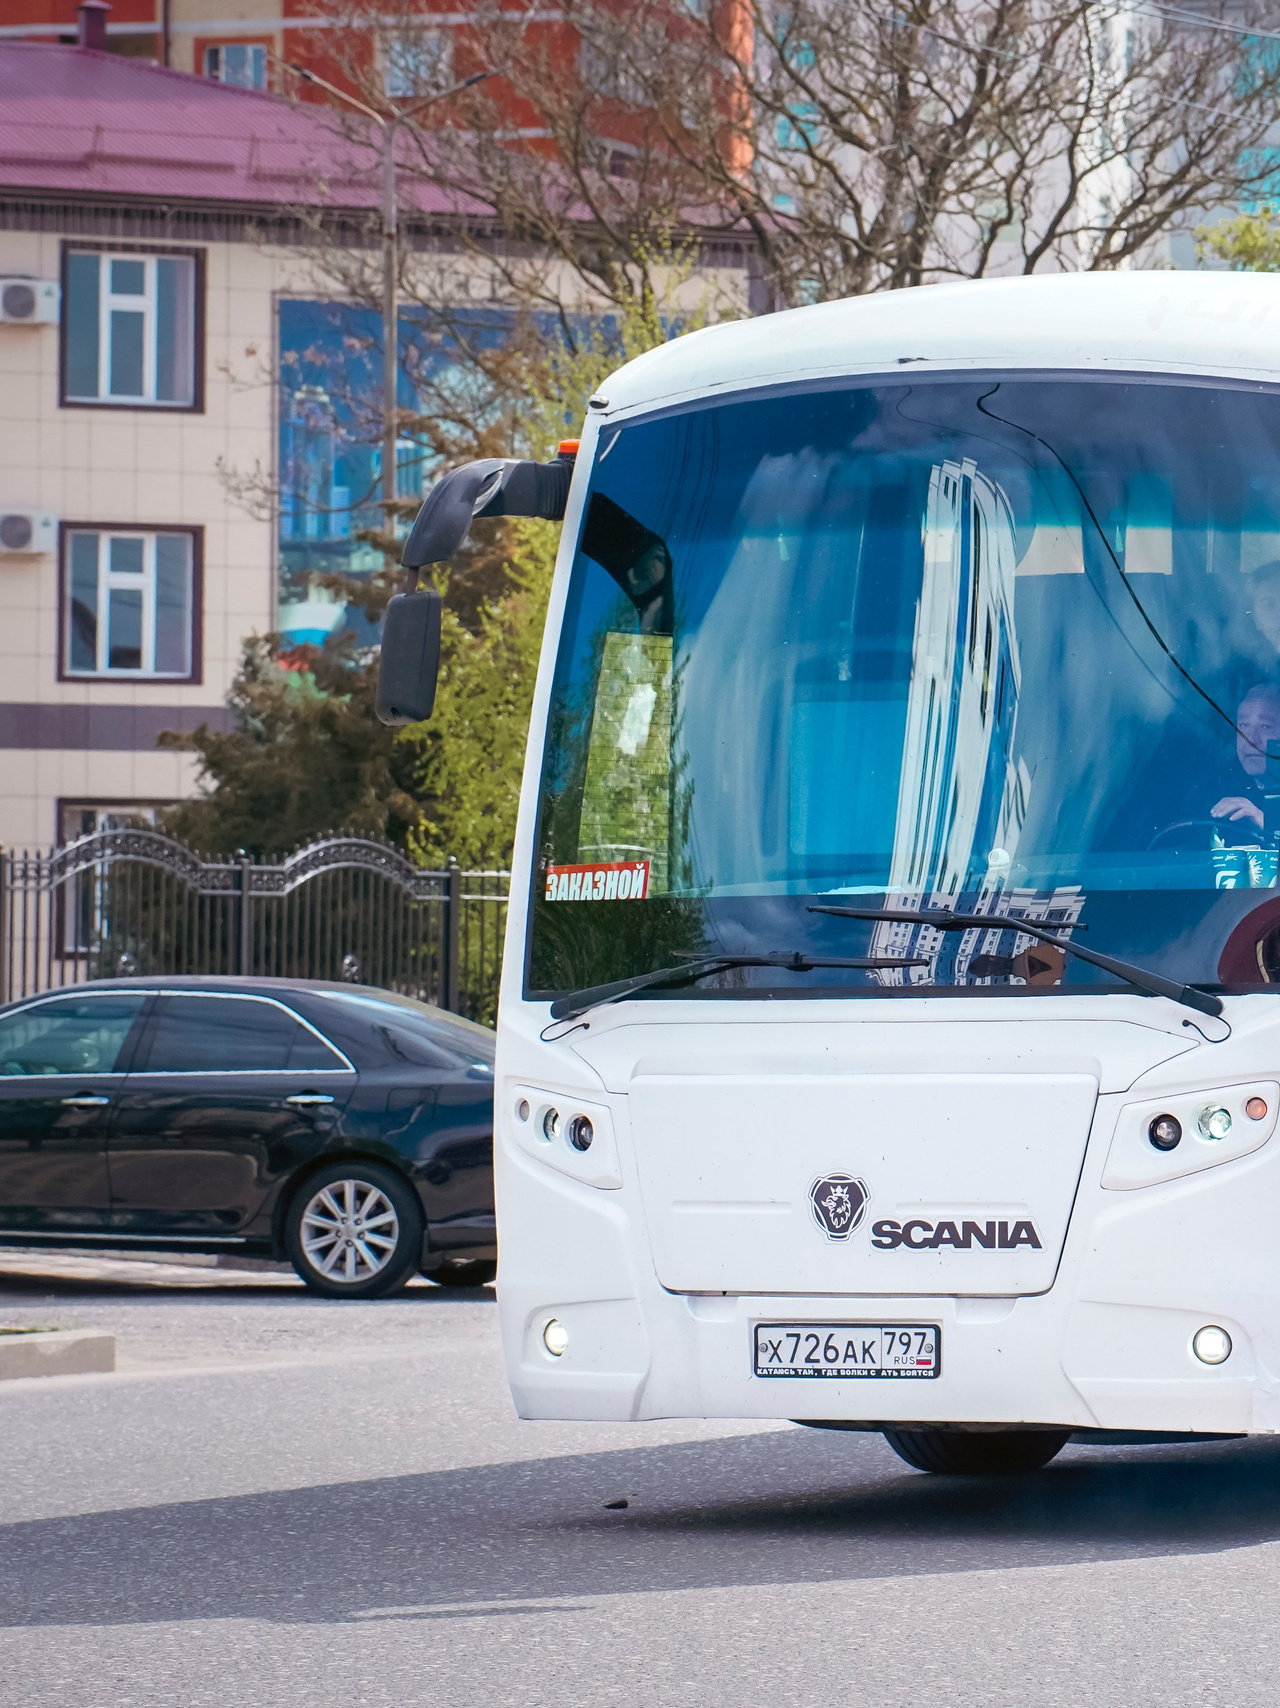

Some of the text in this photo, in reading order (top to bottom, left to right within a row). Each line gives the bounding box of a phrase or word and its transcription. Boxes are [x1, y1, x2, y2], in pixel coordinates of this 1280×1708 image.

[546, 863, 645, 901] ЗАКАЗНОЙ
[871, 1220, 1042, 1249] SCANIA
[768, 1332, 927, 1364] Х726АК 797
[894, 1356, 916, 1365] RUS
